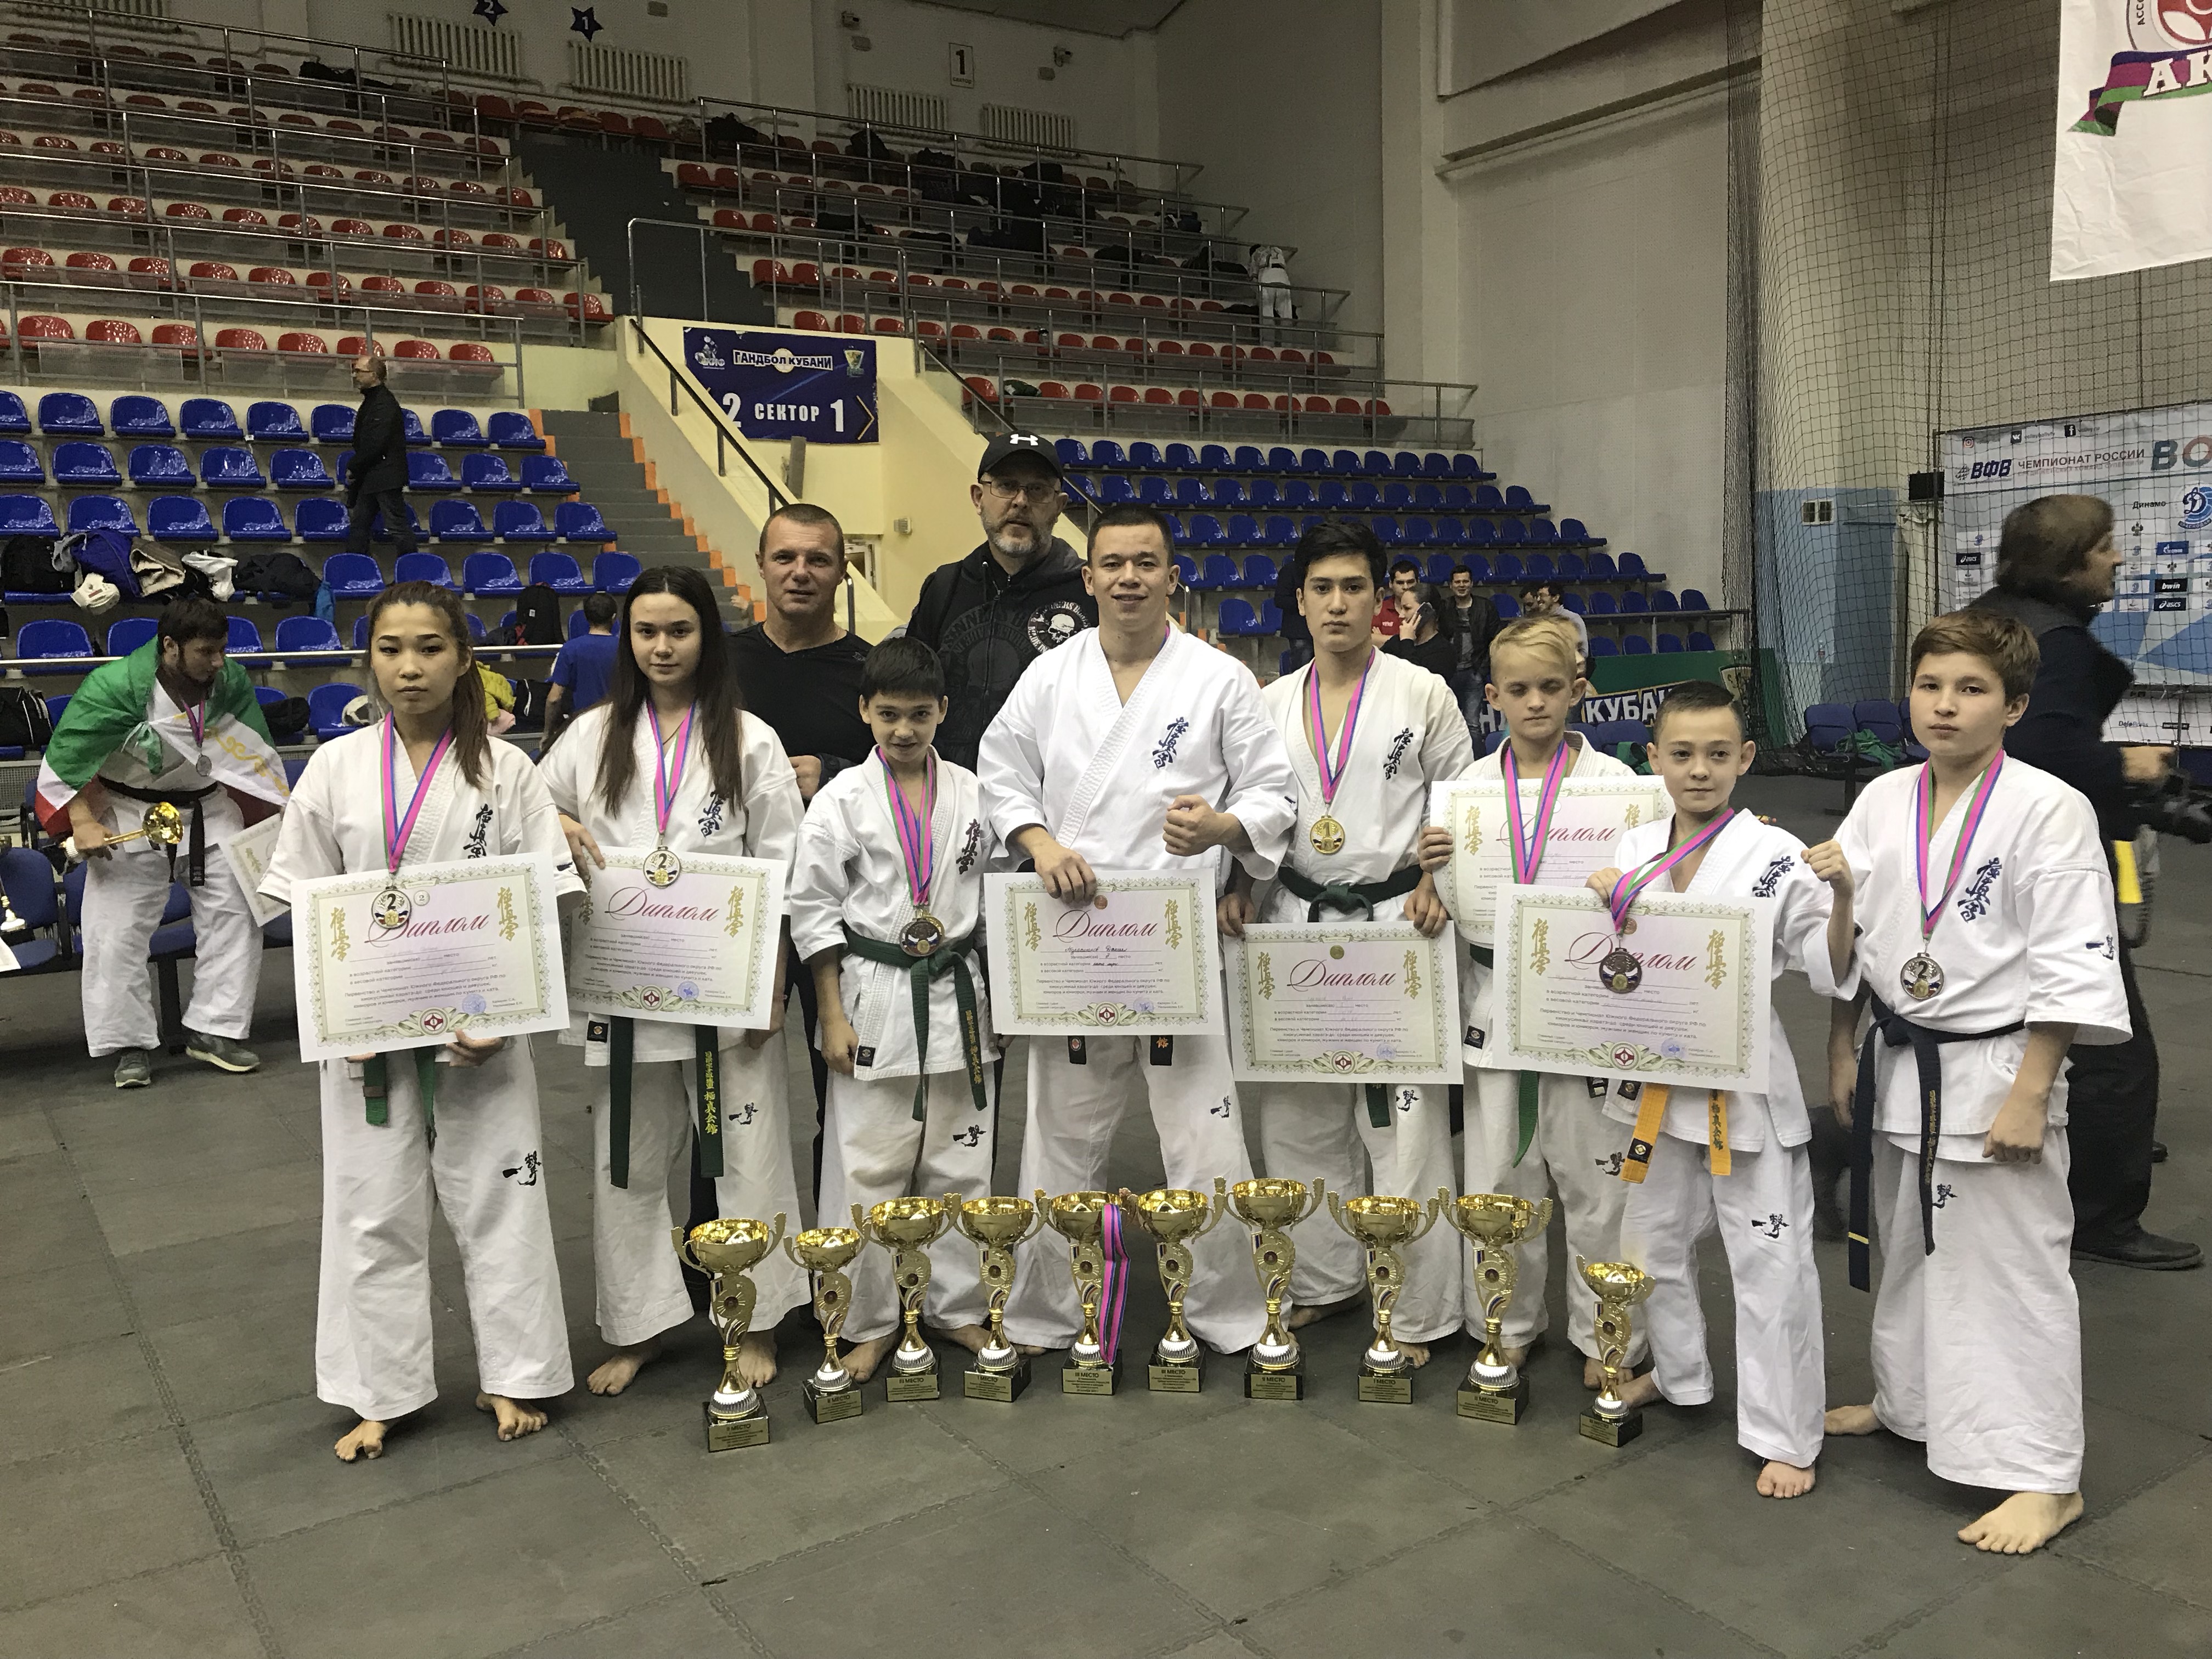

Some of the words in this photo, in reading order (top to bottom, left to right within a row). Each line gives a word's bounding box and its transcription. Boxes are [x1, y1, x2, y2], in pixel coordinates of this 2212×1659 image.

[582, 16, 589, 30] 1
[956, 49, 966, 75] 1
[734, 352, 786, 365] ГАНДБОЛ
[788, 357, 832, 369] КУБАНИ
[723, 392, 742, 428] 2
[754, 403, 820, 422] СЕКТОР
[830, 399, 844, 432] 1
[1971, 459, 2012, 479] ВФВ
[2018, 455, 2091, 469] ЧЕМПИОНАТ
[2095, 449, 2145, 462] РОССИИ
[2132, 501, 2166, 510] Динамо
[1323, 822, 1330, 837] 1
[658, 854, 667, 868] 2
[387, 894, 396, 909] 2
[605, 887, 719, 921] Диплом
[1052, 910, 1158, 943] Диплом
[1564, 932, 1697, 972] Дплом
[1286, 960, 1396, 991] Диплом
[1917, 961, 1927, 979] 2
